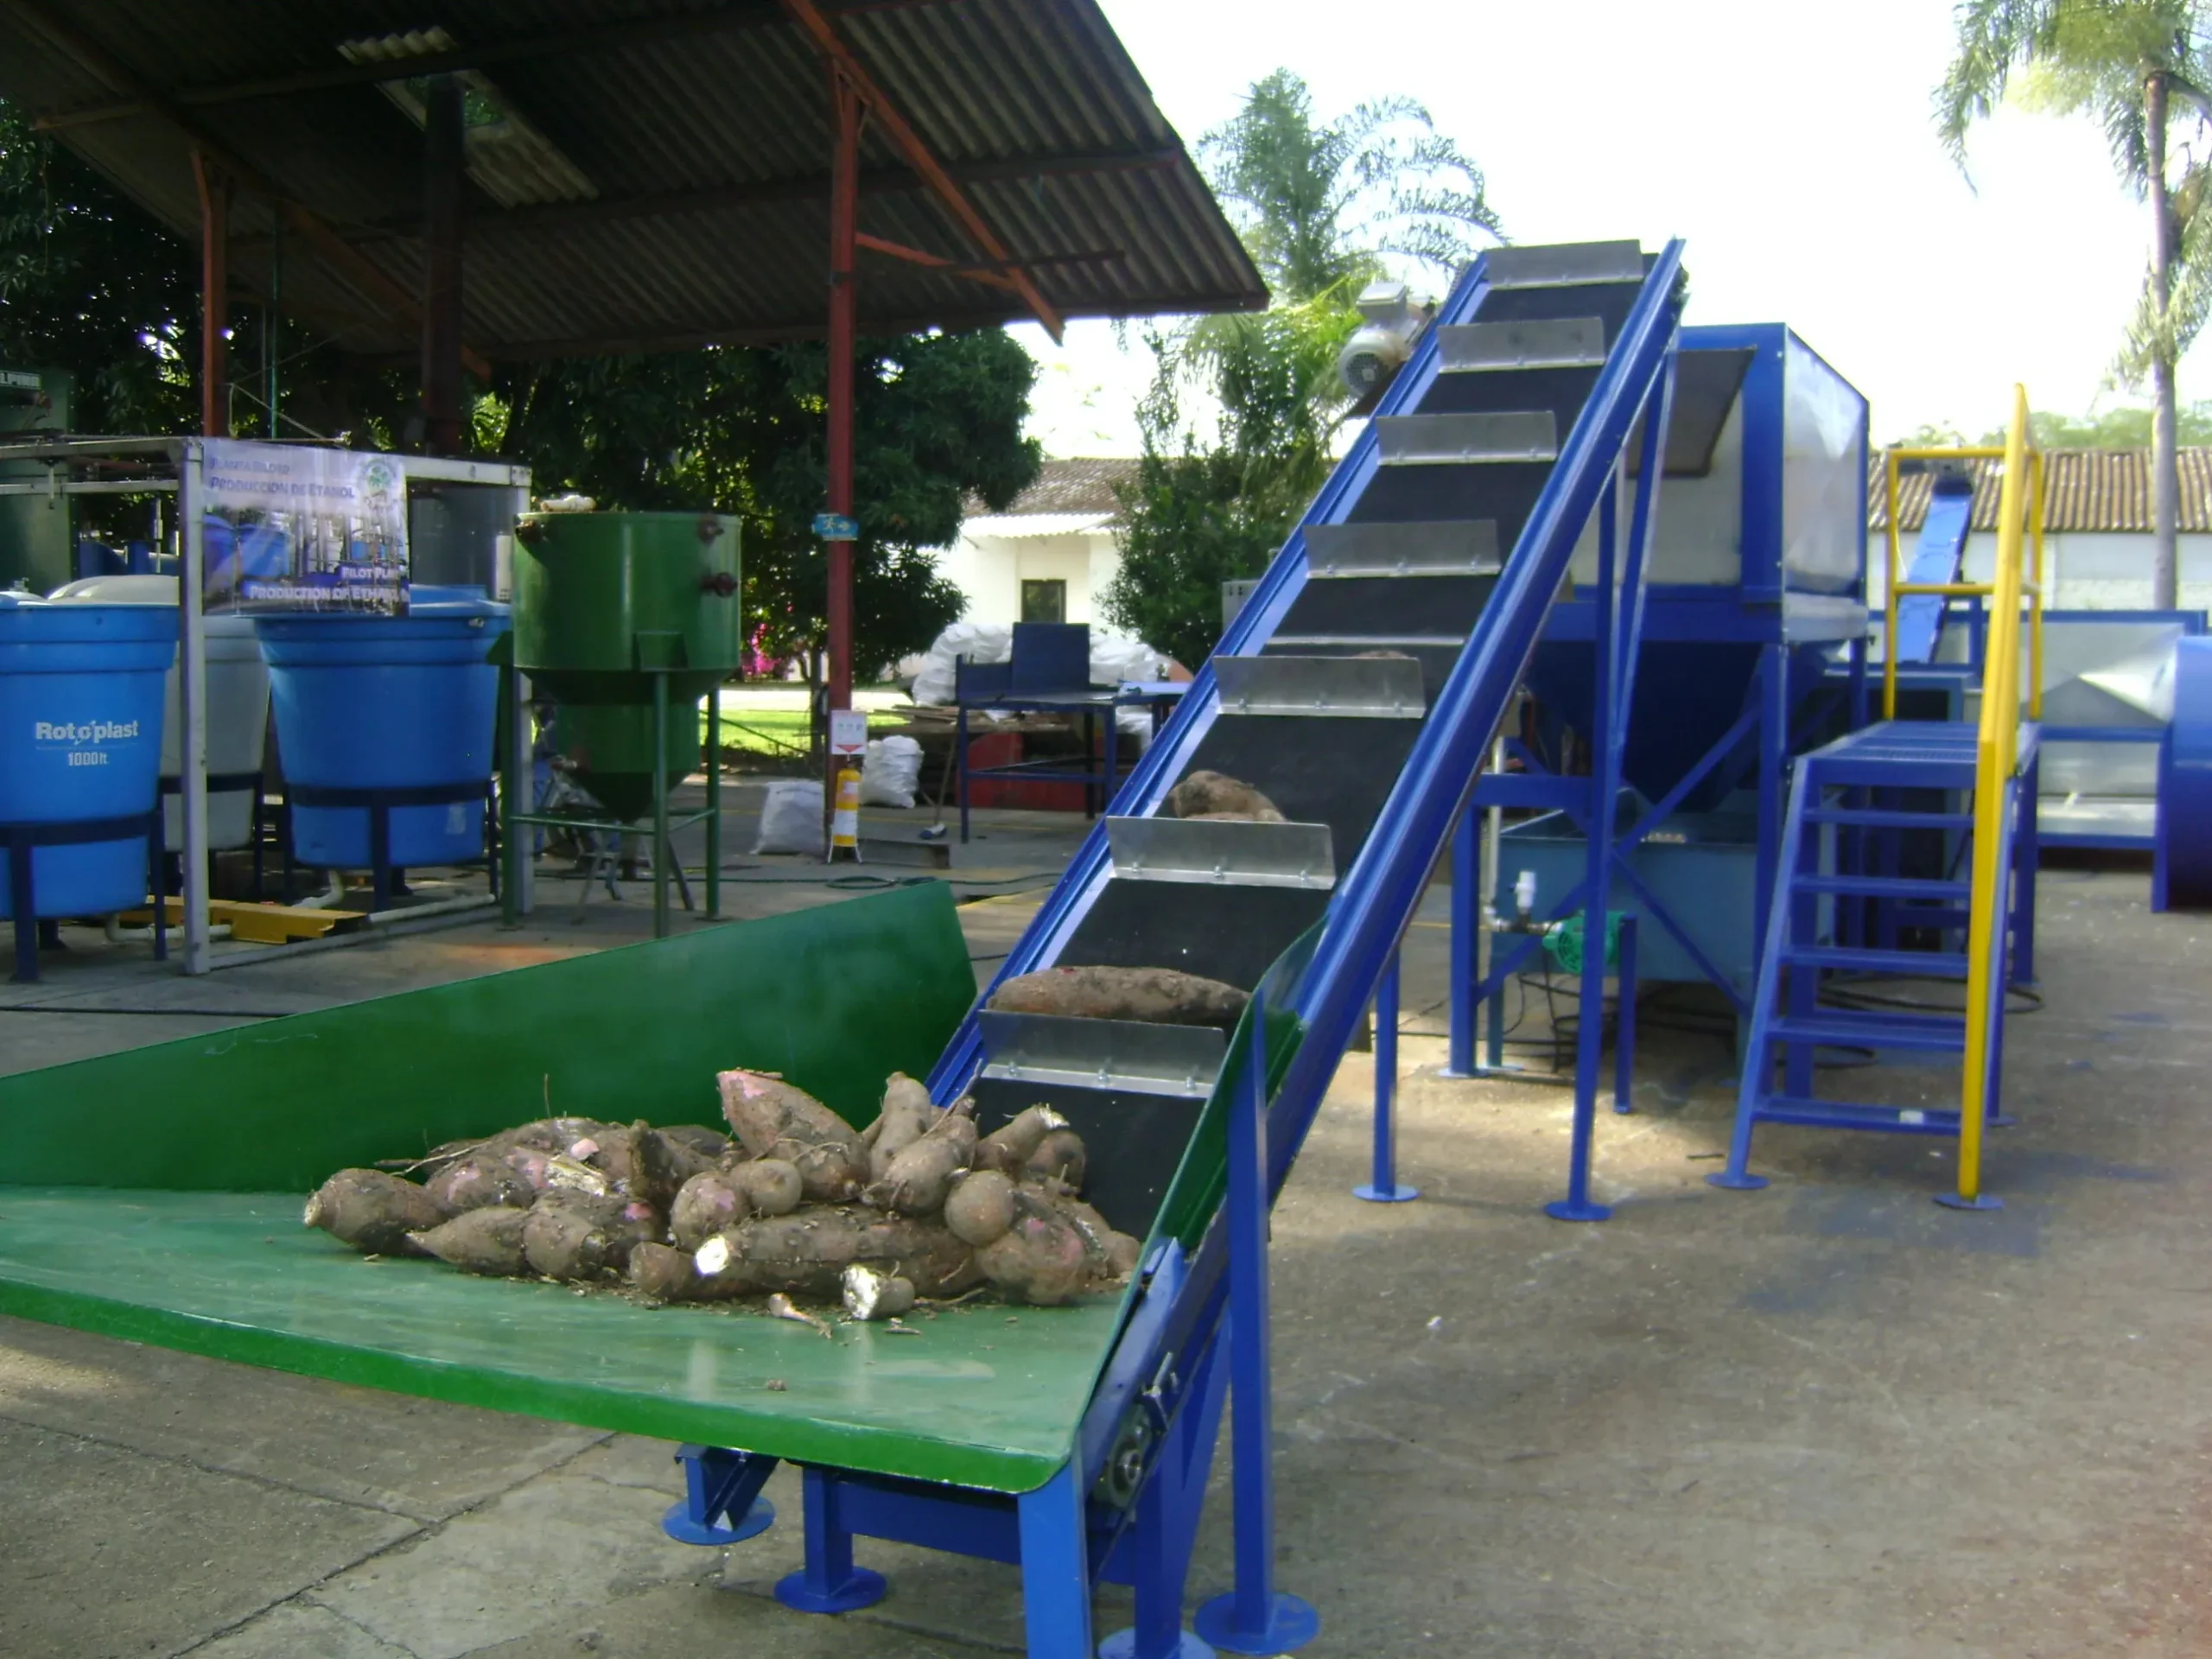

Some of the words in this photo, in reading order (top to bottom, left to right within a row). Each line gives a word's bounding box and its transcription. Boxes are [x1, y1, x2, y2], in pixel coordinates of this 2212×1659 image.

[341, 566, 372, 579] PILOT
[249, 586, 331, 601] PRODUCTION
[35, 720, 138, 744] Rotoplast
